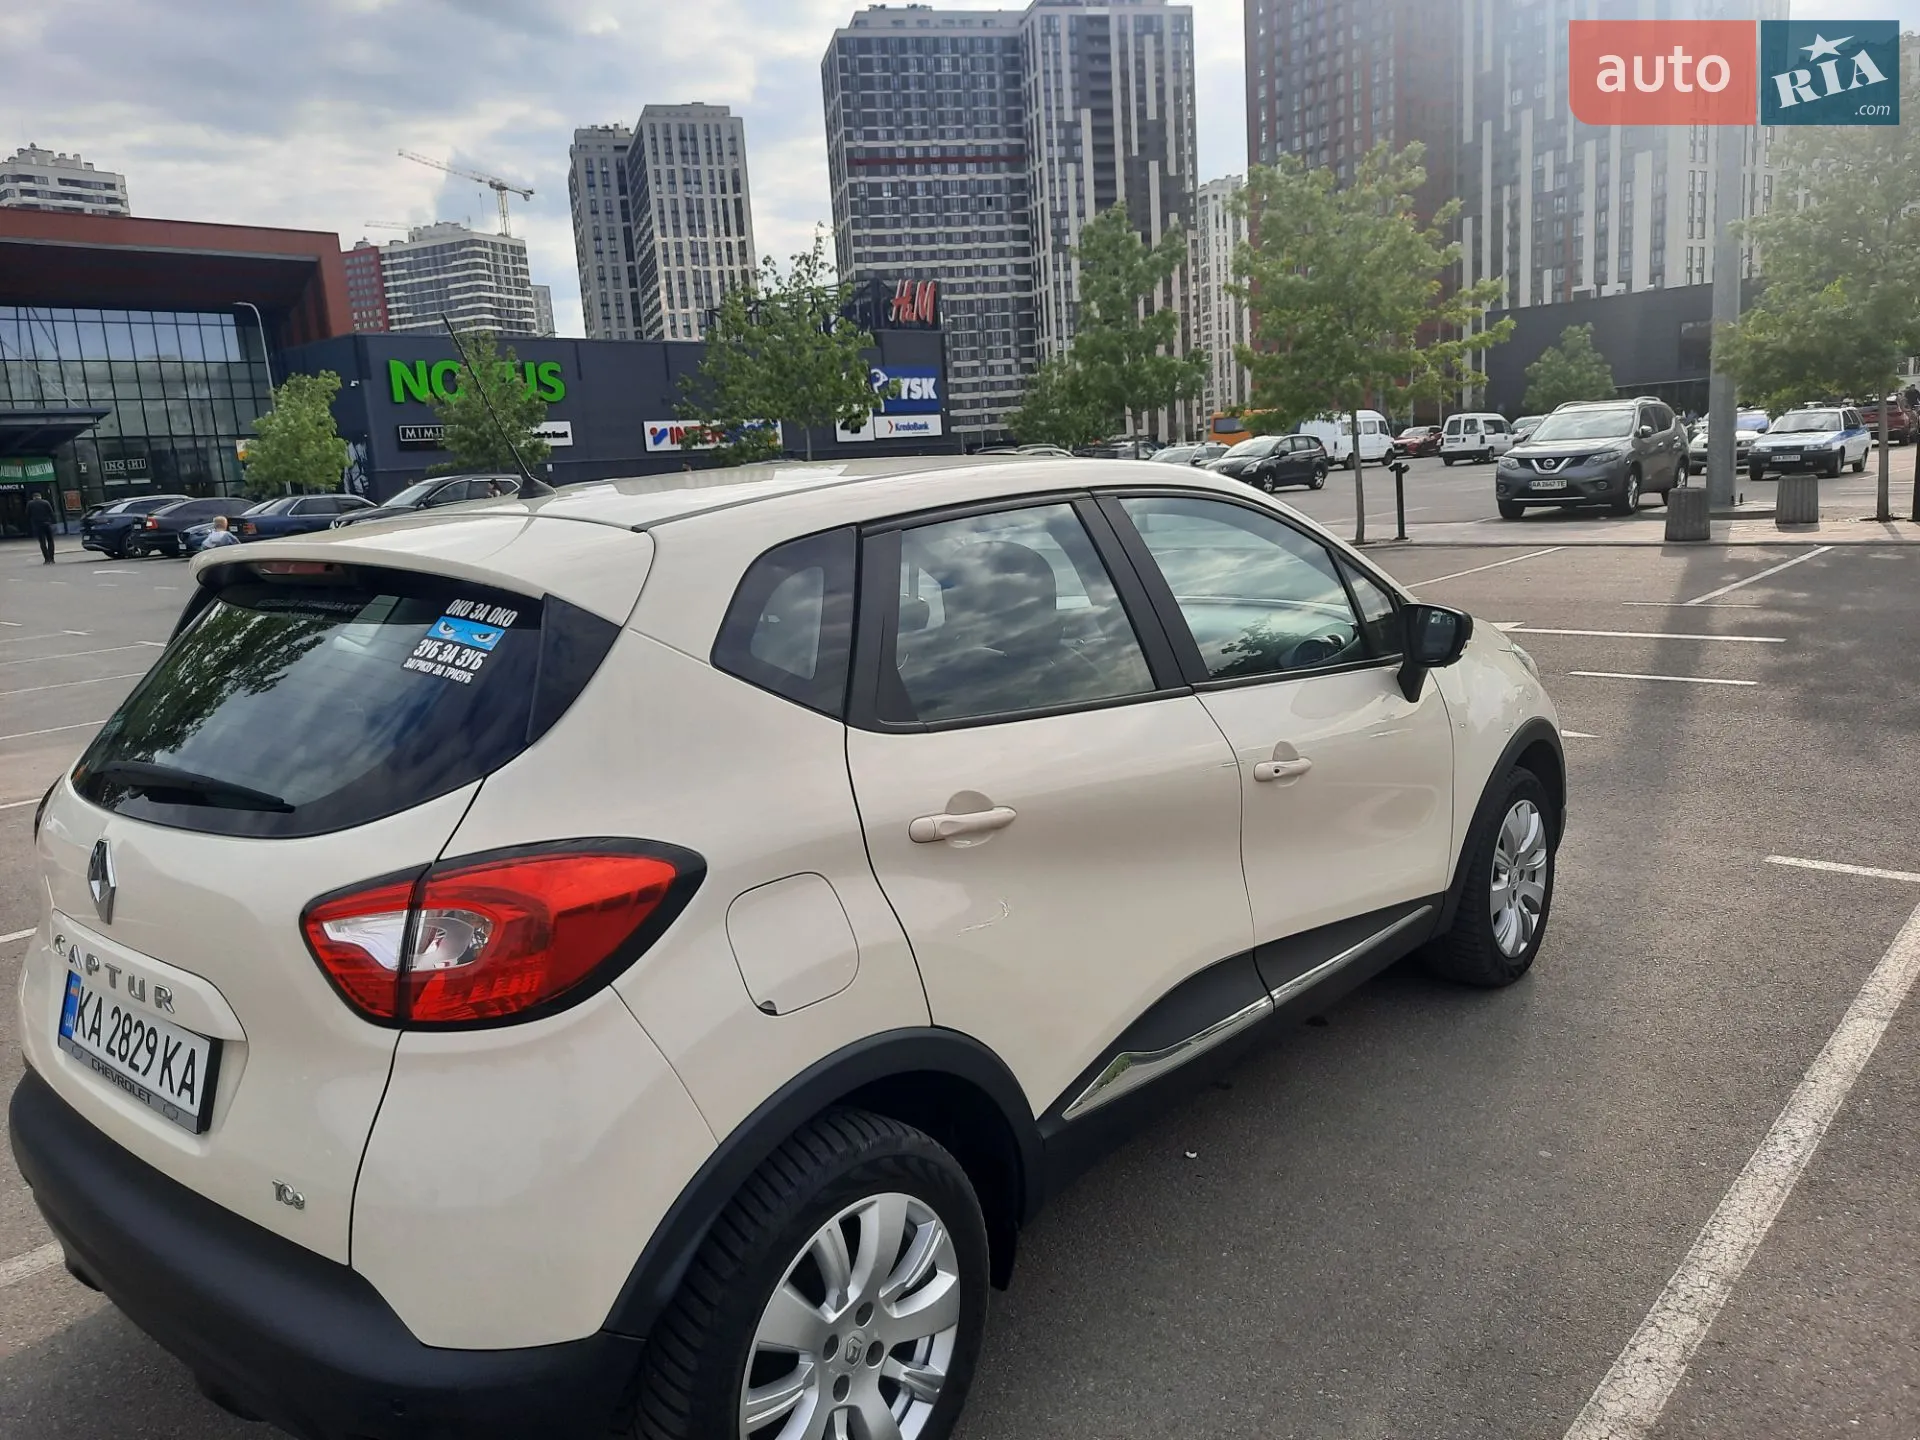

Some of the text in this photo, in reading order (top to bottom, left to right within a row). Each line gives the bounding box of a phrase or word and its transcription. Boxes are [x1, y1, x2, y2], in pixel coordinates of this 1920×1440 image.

[388, 359, 567, 404] NOUS
[895, 420, 930, 432] KredoBank
[446, 599, 518, 628] ОКО ЗА ОКО
[413, 639, 488, 671] ЗУБ ЗА ЗУБ
[54, 934, 176, 1015] CAPTUR
[75, 985, 196, 1107] KA 2829 KA
[91, 1057, 152, 1105] CHEVROLET
